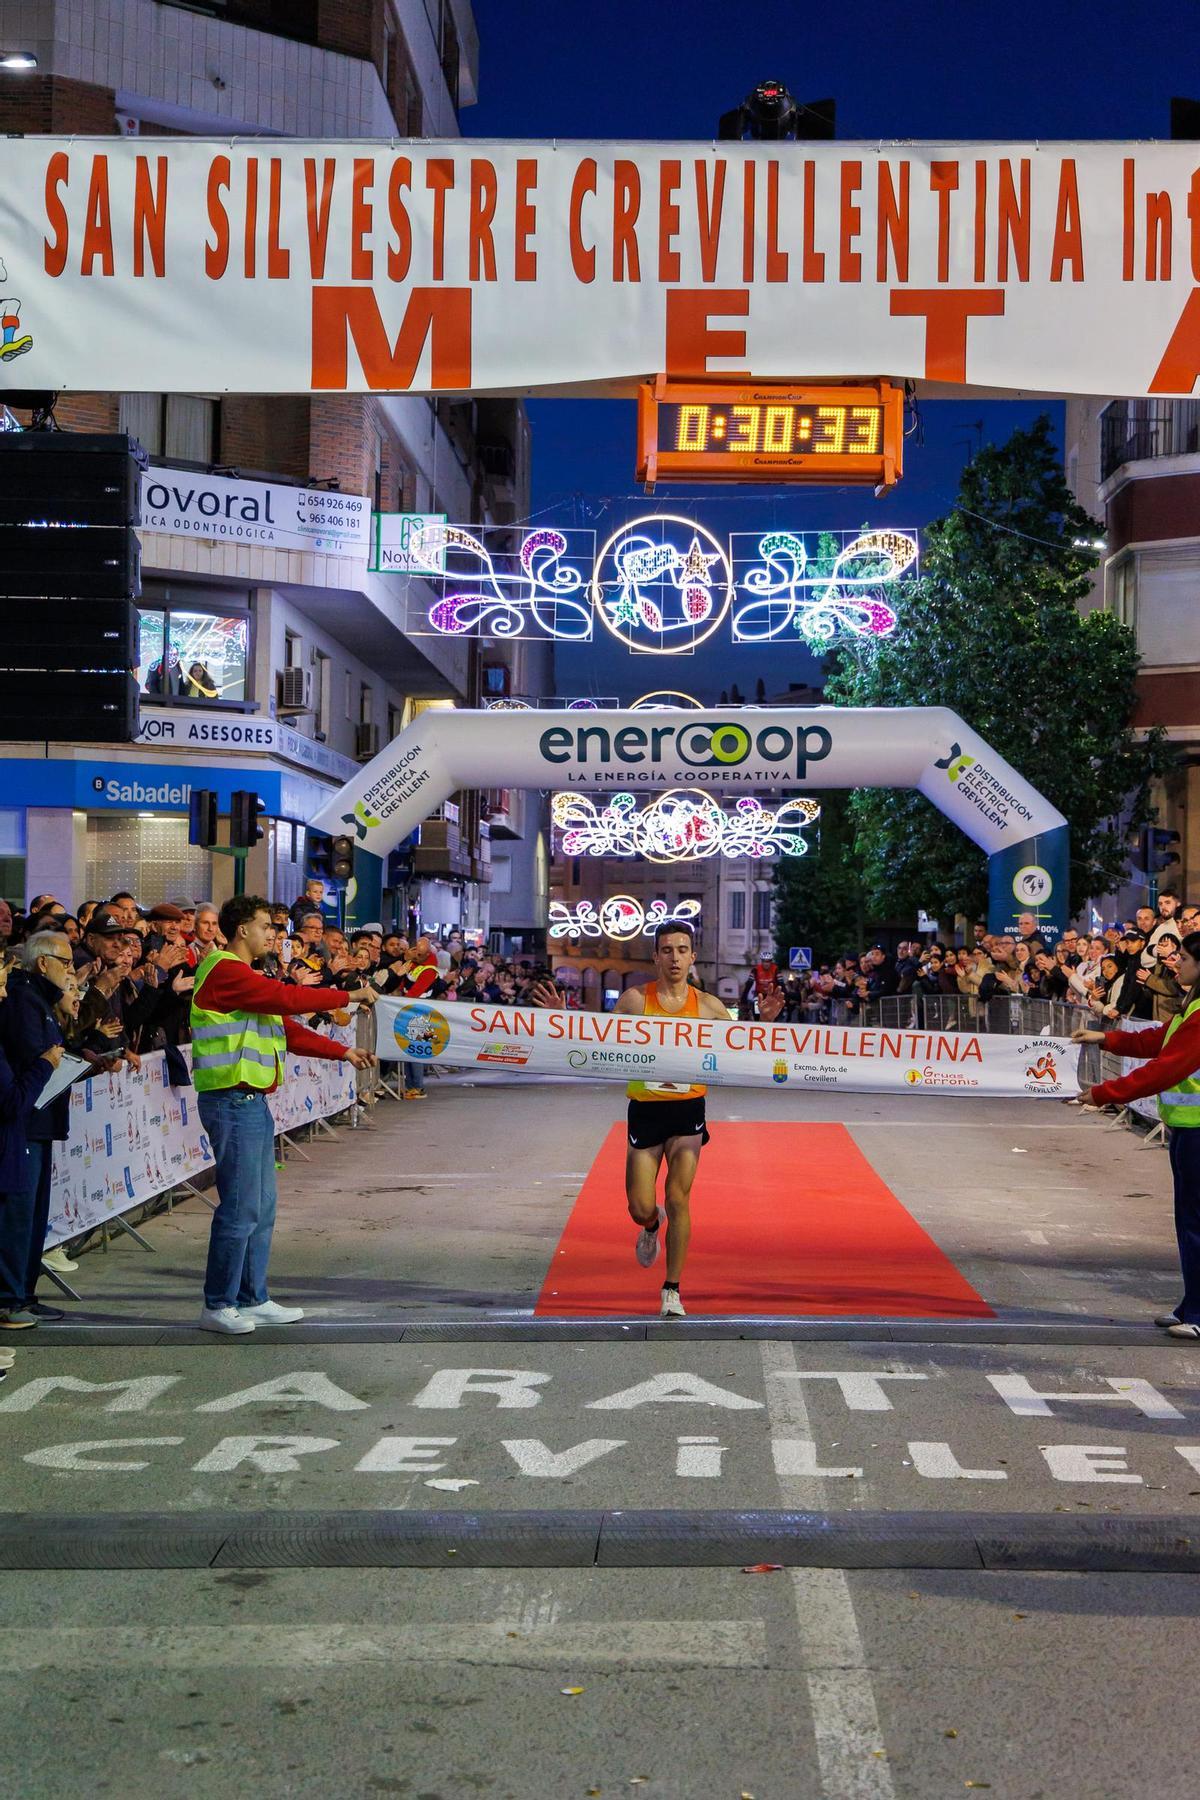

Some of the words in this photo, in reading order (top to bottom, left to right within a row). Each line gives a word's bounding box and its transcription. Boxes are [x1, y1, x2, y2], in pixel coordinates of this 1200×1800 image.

[44, 151, 167, 278] SAN
[205, 155, 538, 283] SILVESTRE
[569, 157, 1084, 283] CREVILLENTINA
[677, 405, 880, 454] 0:30:33
[146, 484, 275, 524] ovoral
[307, 495, 325, 508] 654
[326, 498, 344, 510] 926
[345, 501, 362, 513] 469
[145, 515, 166, 527] ICA
[174, 518, 275, 541] ODONTOLÓGICA
[309, 513, 326, 525] 965
[327, 515, 344, 527] 406
[345, 518, 360, 529] 181
[188, 724, 273, 745] ASESORES
[539, 722, 833, 780] enercoop
[568, 772, 582, 782] LA
[594, 770, 666, 782] ENERGÍA
[674, 771, 791, 782] COOPERATIVA
[106, 780, 192, 804] Sabadell
[381, 770, 430, 818] CREVILLENT
[957, 782, 1008, 830] CREVILLENT
[470, 1007, 535, 1037] SAN
[548, 1014, 713, 1049] SILVESTRE
[725, 1025, 983, 1063] CREVILLENTINA
[407, 1044, 432, 1056] SSC
[592, 1051, 656, 1064] ENERCOOP
[1032, 1040, 1066, 1055] MARATHON
[794, 1063, 818, 1072] Excmo.
[819, 1065, 838, 1073] Ayto.
[804, 1074, 837, 1083] Crevillent
[1024, 1082, 1062, 1093] CREVILLENT
